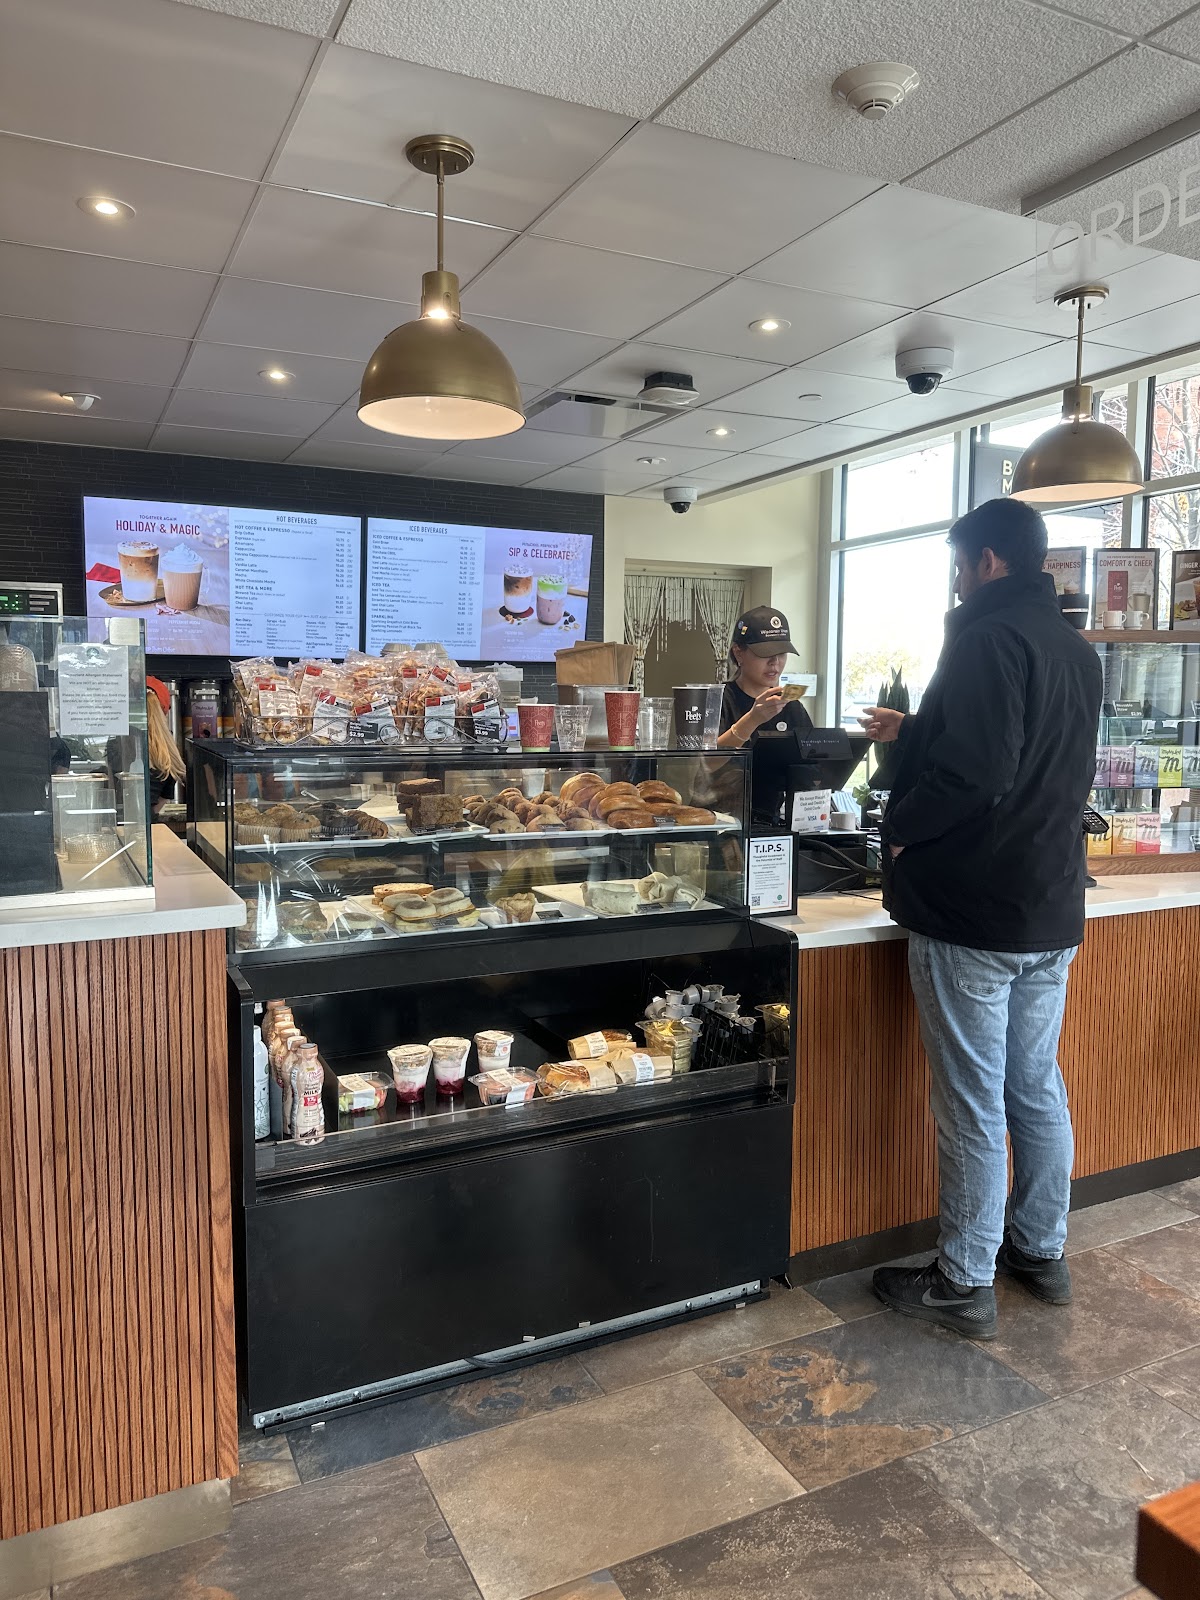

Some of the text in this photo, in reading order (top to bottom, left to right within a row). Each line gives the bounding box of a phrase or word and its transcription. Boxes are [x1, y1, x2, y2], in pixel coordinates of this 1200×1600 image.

[287, 516, 317, 524] BEVERAGES
[116, 520, 200, 535] HOLIDAY & MAGIC
[509, 547, 570, 560] SIP & CELEBRATE
[754, 844, 784, 853] T.I.P.S.
